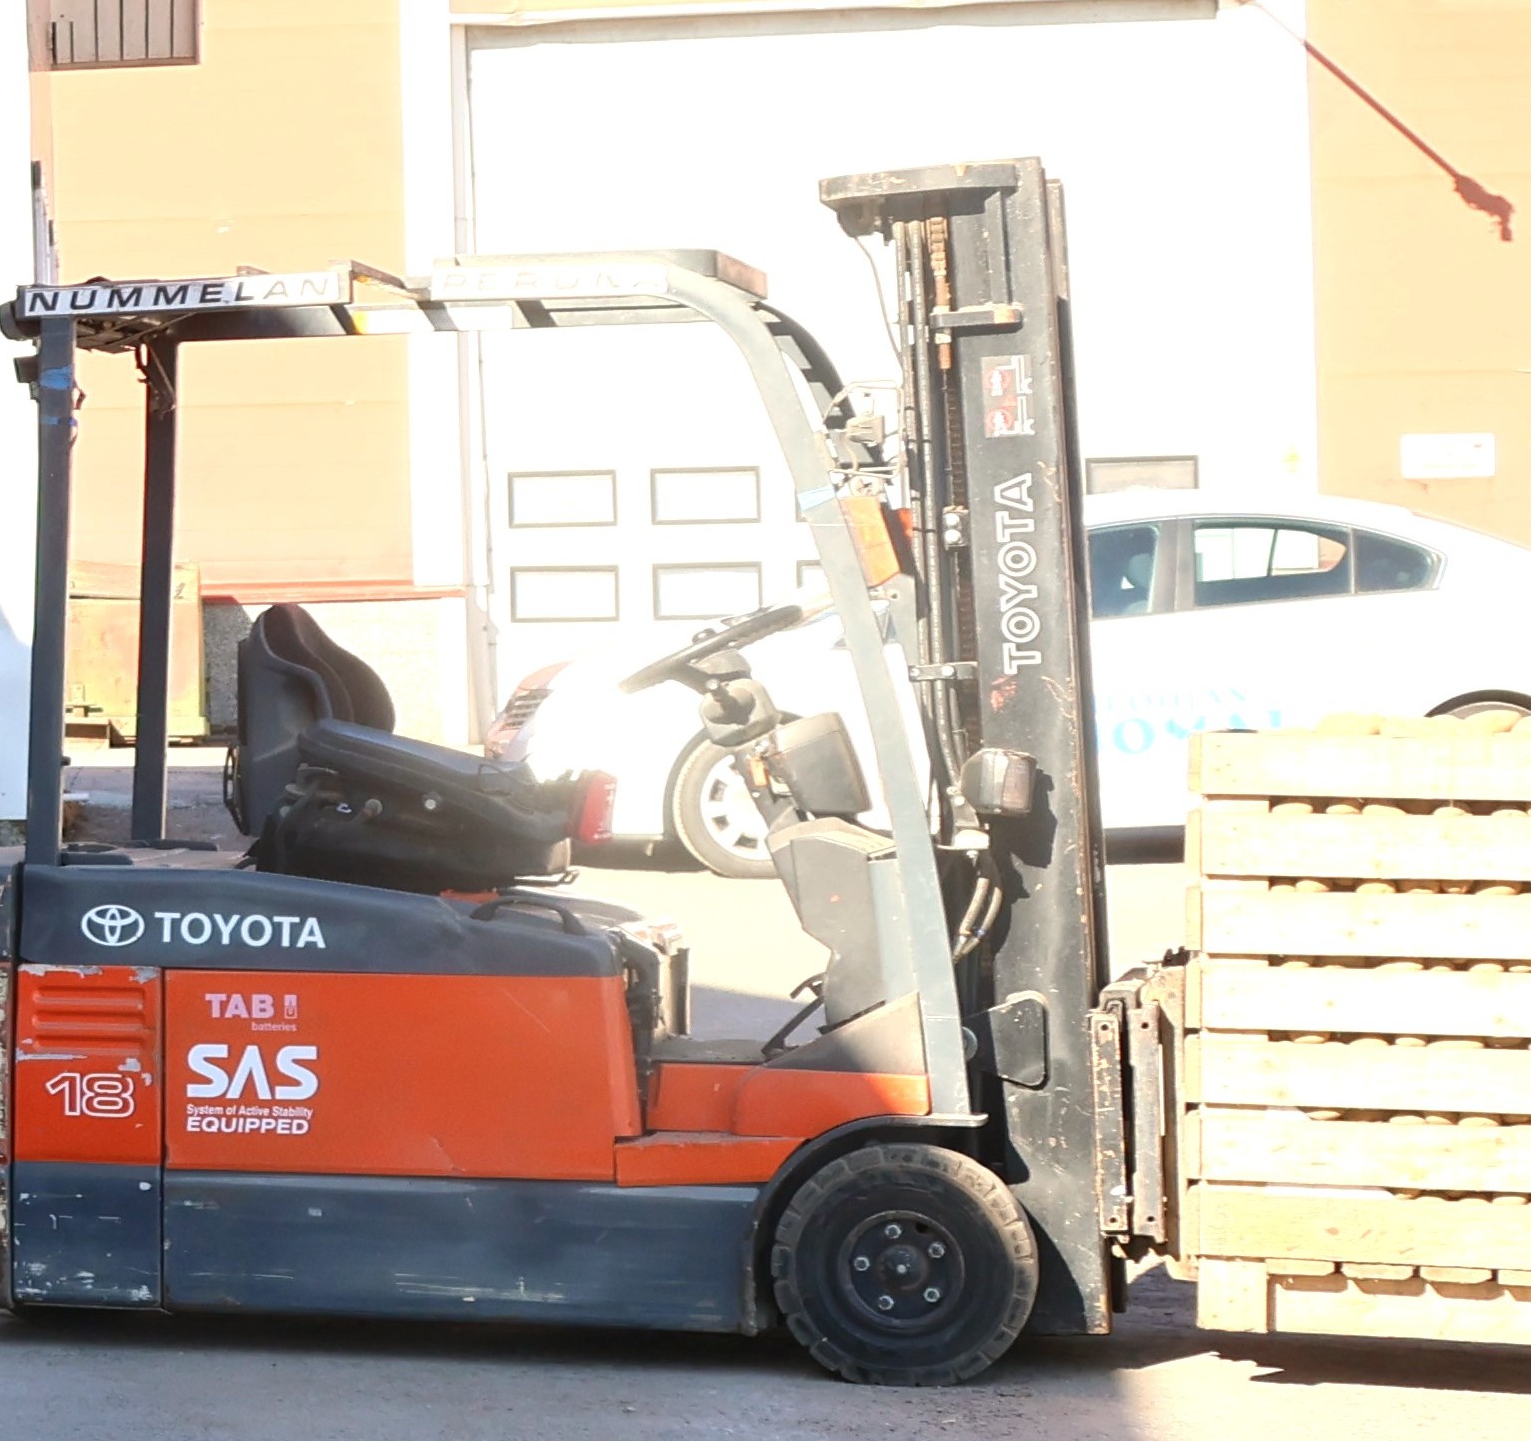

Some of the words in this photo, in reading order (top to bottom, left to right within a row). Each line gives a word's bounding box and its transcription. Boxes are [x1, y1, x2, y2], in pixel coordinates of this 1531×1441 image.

[27, 276, 332, 313] NUMMELAN
[993, 471, 1042, 675] TOYOTA
[154, 911, 326, 949] TOYOTA
[205, 993, 275, 1019] TAB
[251, 1020, 297, 1032] batteries
[186, 1043, 319, 1100] SAS
[45, 1072, 135, 1118] 18
[186, 1103, 224, 1117] System
[225, 1104, 237, 1115] of
[238, 1105, 270, 1116] Active
[272, 1106, 314, 1120] Stability
[186, 1116, 309, 1135] EQUIPPED
